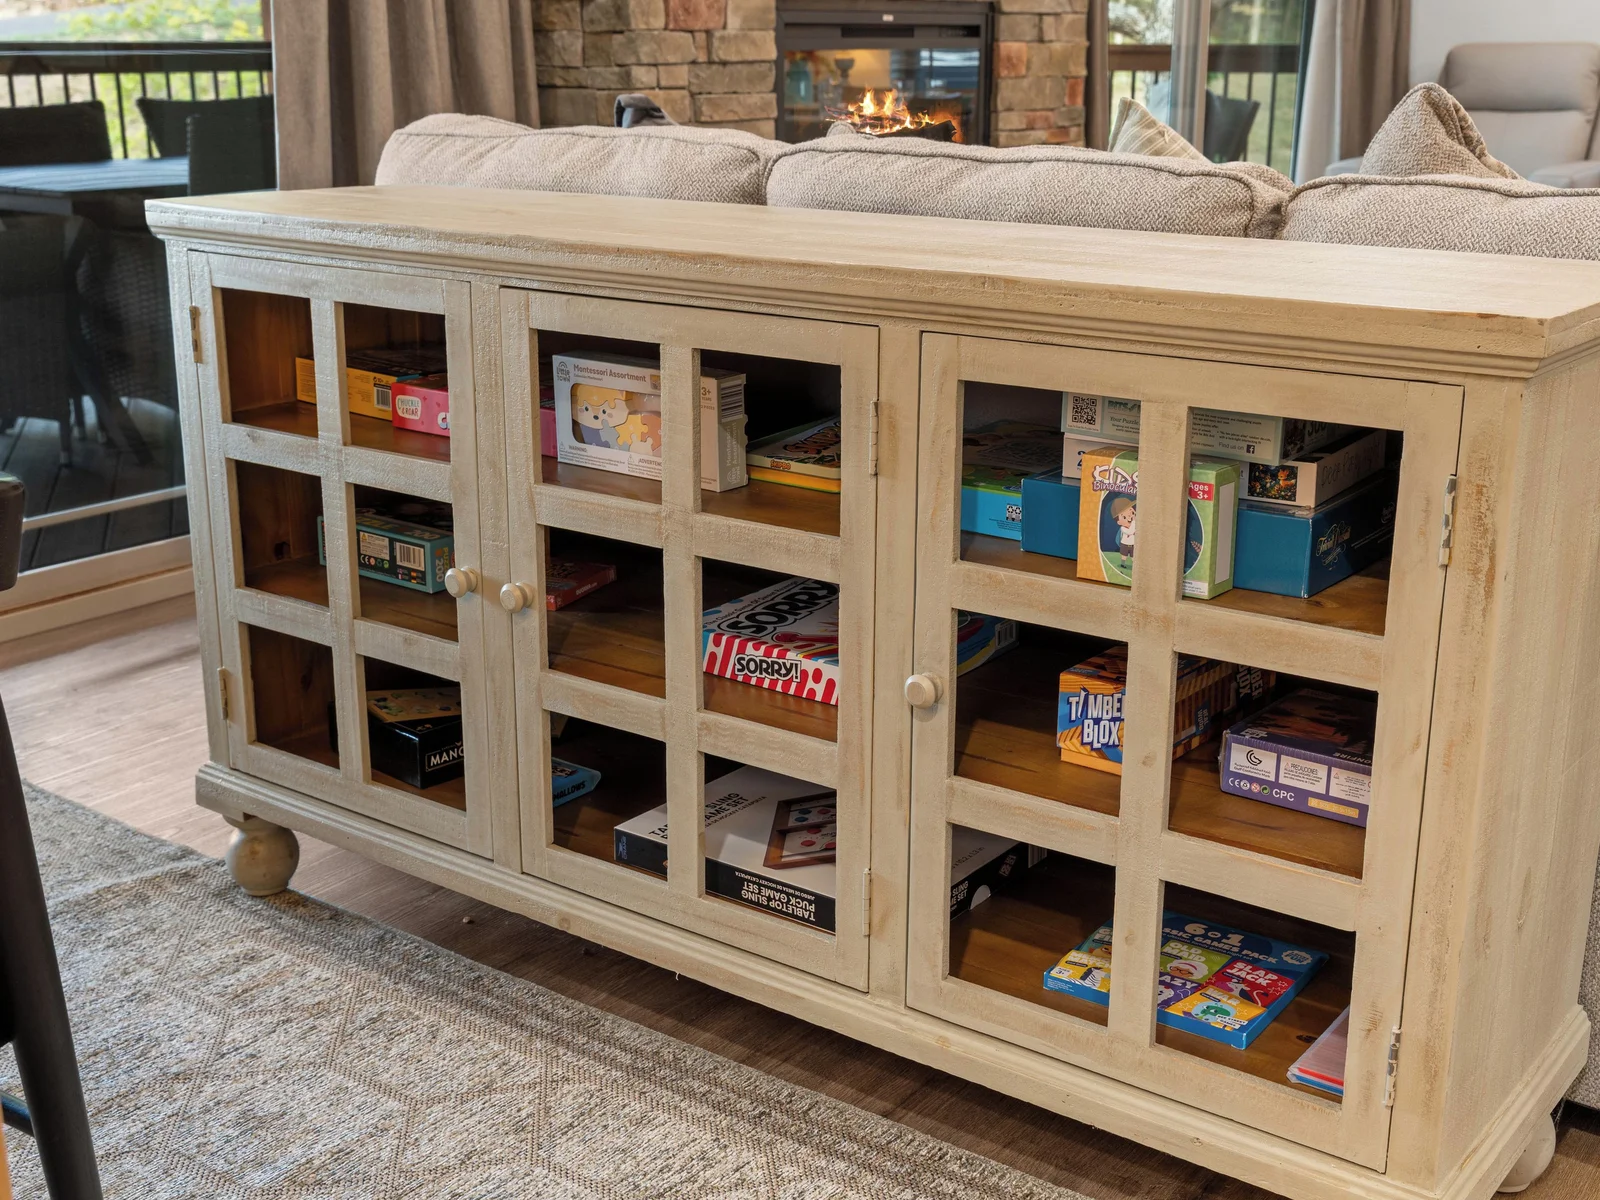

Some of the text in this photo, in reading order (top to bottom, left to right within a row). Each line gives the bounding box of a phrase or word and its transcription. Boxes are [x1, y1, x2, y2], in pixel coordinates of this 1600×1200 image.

[574, 364, 647, 382] Montessori Assortment
[701, 387, 711, 396] 3+
[1219, 441, 1230, 449] Find
[1189, 482, 1209, 492] Ages
[1197, 491, 1208, 499] 3+
[435, 558, 445, 582] 200
[736, 656, 799, 680] SORRY!
[1083, 719, 1120, 749] BLOX
[1333, 752, 1372, 764] ONFIRE
[705, 792, 740, 809] SLING
[726, 796, 749, 808] SET
[1272, 788, 1295, 801] CPC
[735, 871, 760, 883] CATAPULTA
[759, 880, 777, 888] HOCKEY
[952, 880, 969, 896] SLING
[957, 888, 968, 902] SET
[742, 881, 815, 912] PUCK GAME SET
[741, 889, 816, 922] TABLETOP SLING
[1184, 923, 1209, 935] 6
[1221, 933, 1245, 947] 1
[1162, 946, 1207, 962] MAID
[1169, 942, 1202, 954] OLD
[1193, 936, 1240, 953] GAMES
[1241, 949, 1279, 964] PACK
[1226, 967, 1272, 987] JACK
[1233, 961, 1278, 980] SLAP
[1160, 975, 1198, 989] AZY
[1205, 987, 1241, 1006] WAR
[1219, 1019, 1236, 1027] GAMES
